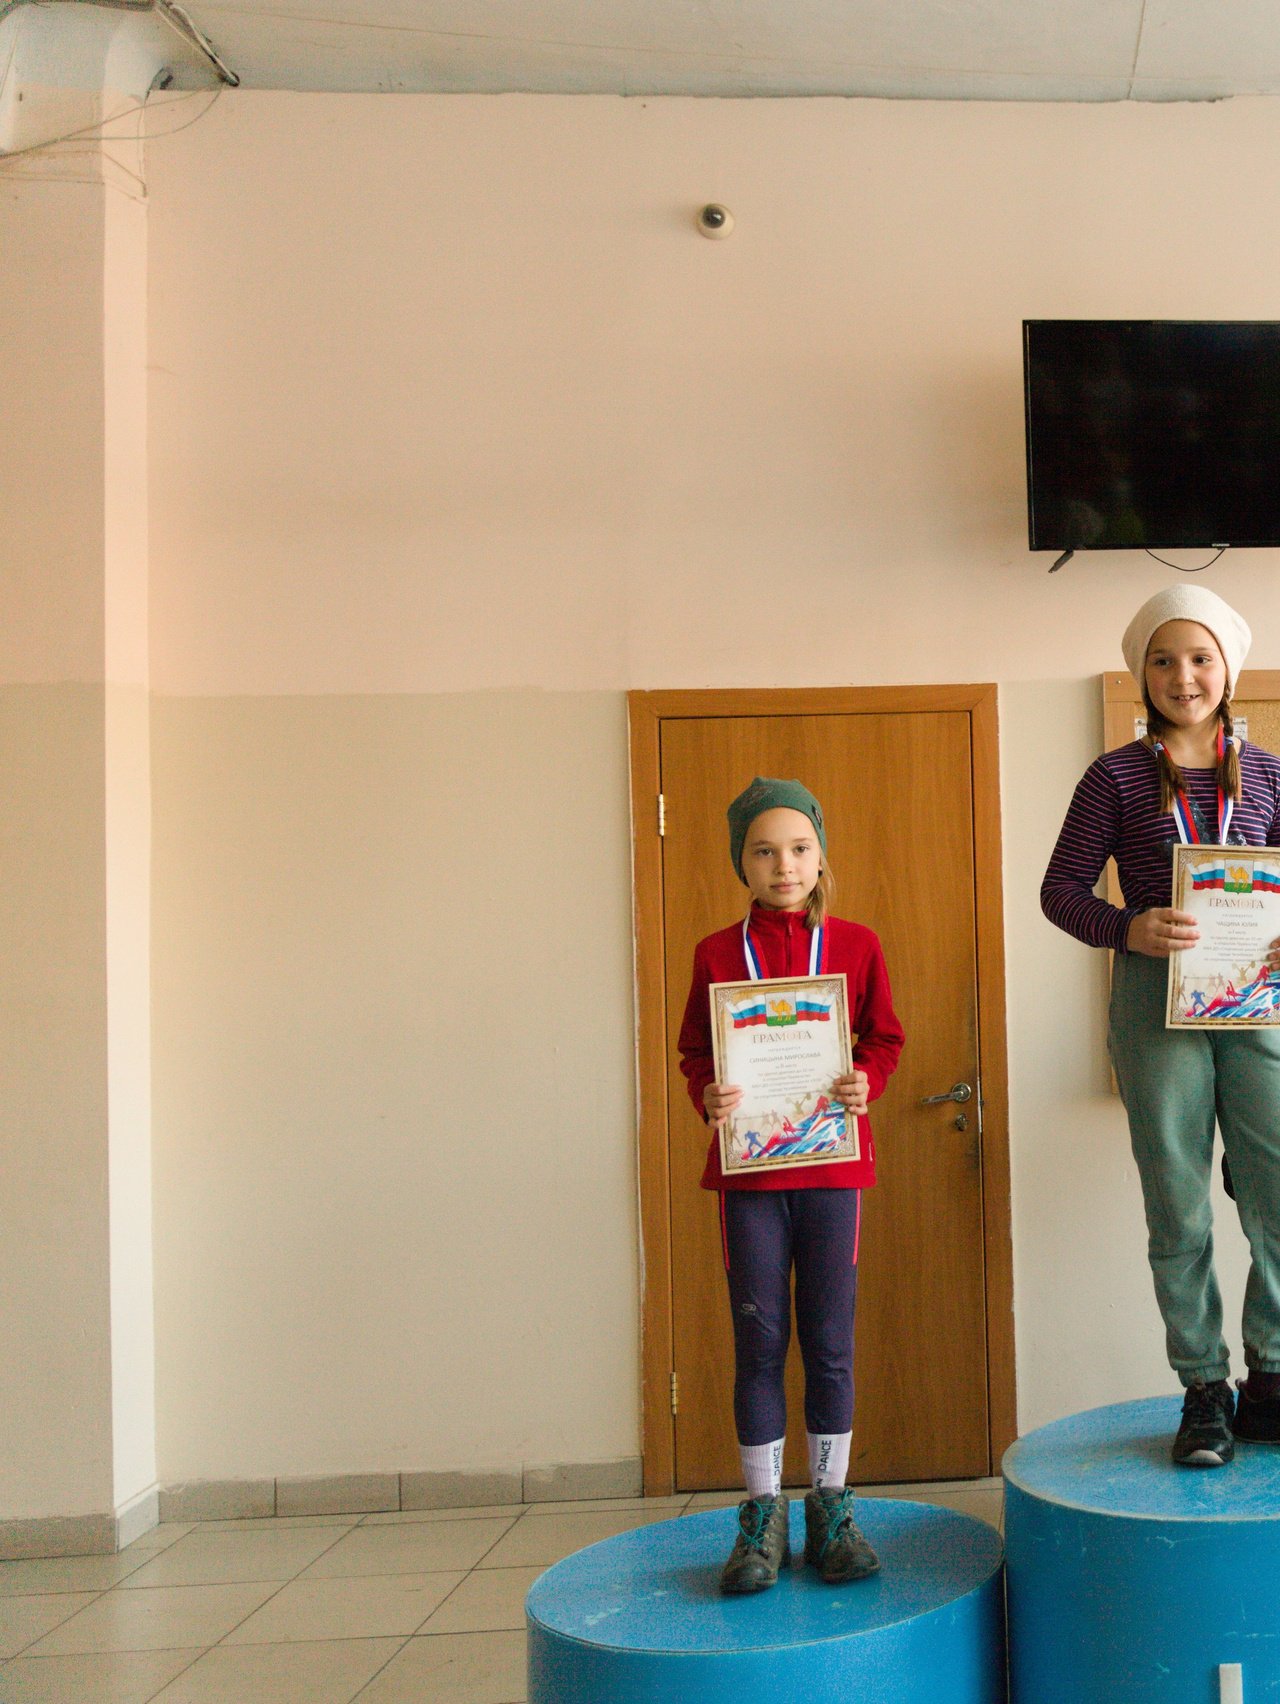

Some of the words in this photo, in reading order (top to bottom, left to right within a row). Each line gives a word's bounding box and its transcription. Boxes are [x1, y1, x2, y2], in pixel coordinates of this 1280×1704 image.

[1208, 898, 1265, 909] ГРАМОТА
[752, 1030, 812, 1044] ГРАМОТА
[749, 1055, 784, 1063] СИНИЦЫНА
[784, 1052, 822, 1061] МИРОСЛАВА
[773, 1445, 781, 1476] DANCE
[817, 1440, 832, 1471] DANCE
